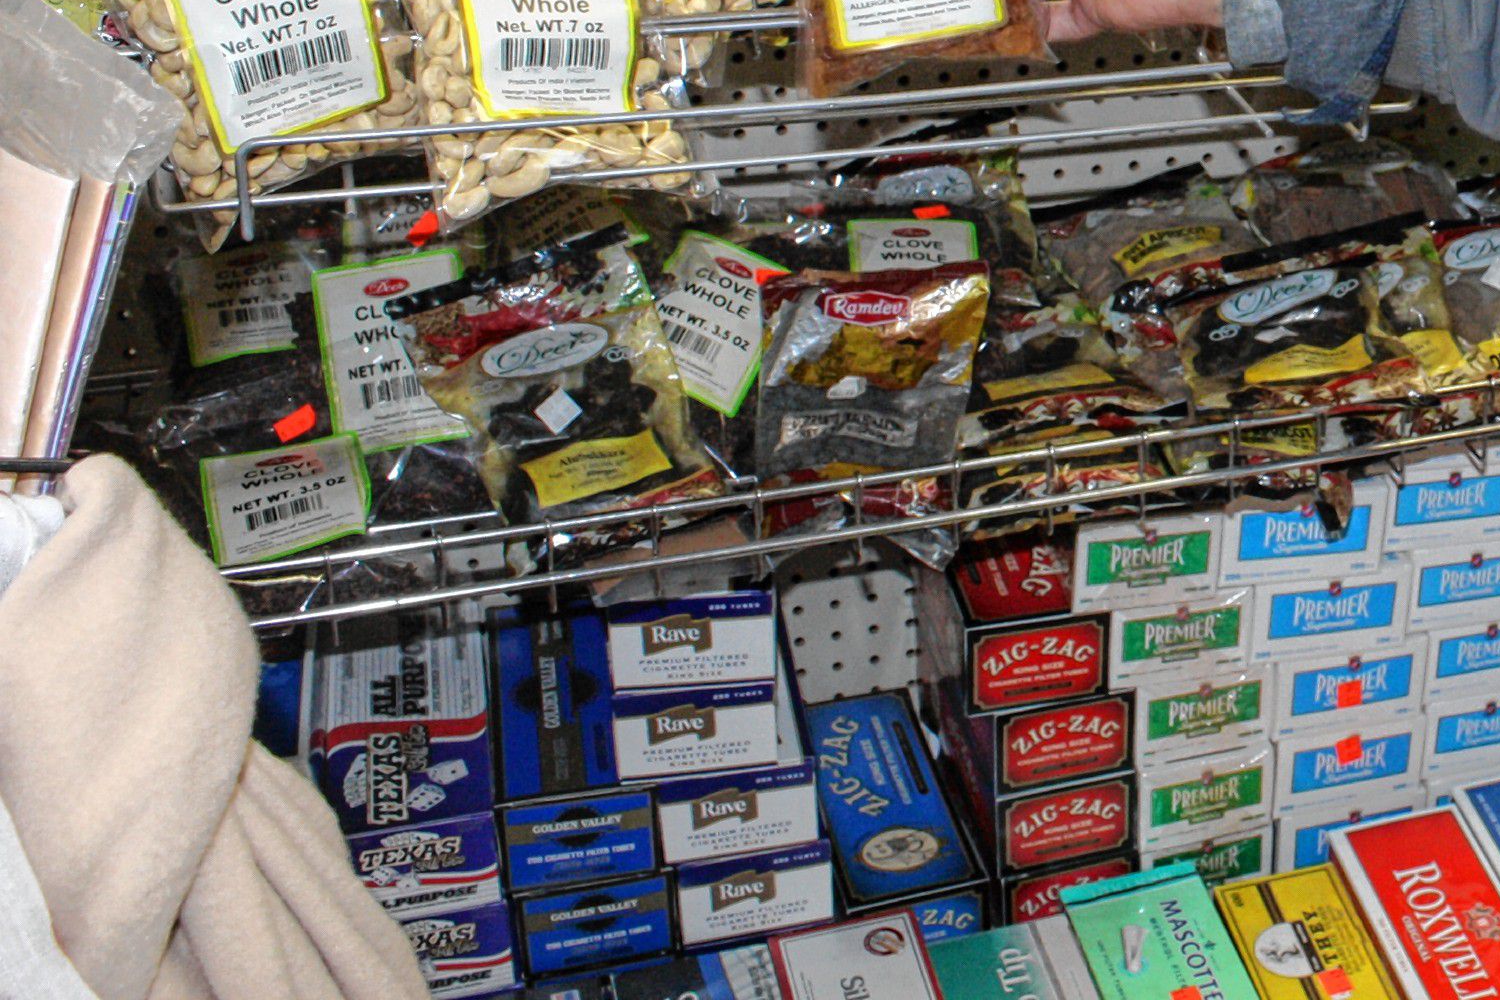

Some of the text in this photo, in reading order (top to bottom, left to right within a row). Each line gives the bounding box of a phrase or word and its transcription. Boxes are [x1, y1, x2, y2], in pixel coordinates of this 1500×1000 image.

[221, 34, 260, 58] Net.
[316, 14, 338, 31] oz
[585, 22, 604, 34] oz
[880, 251, 949, 264] WHOLE
[882, 239, 944, 251] CLOVE
[215, 272, 294, 291] WHOLE
[696, 267, 757, 301] CLOVE
[683, 280, 751, 320] WHOLE
[833, 297, 904, 319] Ramdev
[657, 303, 751, 352] NET WT. 3.5 OZ
[348, 359, 408, 380] NET WT.
[241, 466, 320, 490] WHOLE
[244, 460, 320, 479] CLOVE
[232, 475, 347, 514] NET WT. 3.5 OZ
[1417, 479, 1488, 514] PREMIER
[1110, 537, 1187, 573] PREMIER
[1293, 589, 1373, 626] PREMIER
[651, 624, 701, 645] Rave
[1144, 614, 1217, 653] PREMIER
[639, 653, 749, 665] PREMIUM FILTERED
[643, 660, 747, 673] CIGARETTE TUBES
[982, 636, 1095, 677] ZIG-ZAG
[370, 675, 398, 717] ALL
[543, 691, 560, 730] GOLDEN
[1169, 693, 1239, 729] PREMIER
[656, 715, 705, 735] Rave
[1011, 715, 1121, 755] ZIG-ZAG
[367, 732, 409, 824] TEXAS
[819, 714, 890, 817] ZIG-ZAG
[700, 799, 747, 819] Rave
[1171, 777, 1241, 816] PREMIER
[532, 814, 623, 835] GOLDEN VALLEY
[1014, 798, 1122, 839] ZIG-ZAG
[360, 835, 462, 872] TEXAS
[392, 884, 478, 908] PURPOSE
[719, 881, 765, 900] Rave
[551, 899, 639, 923] GOLDEN VALLEY
[1160, 899, 1225, 1000] MASCOTTE
